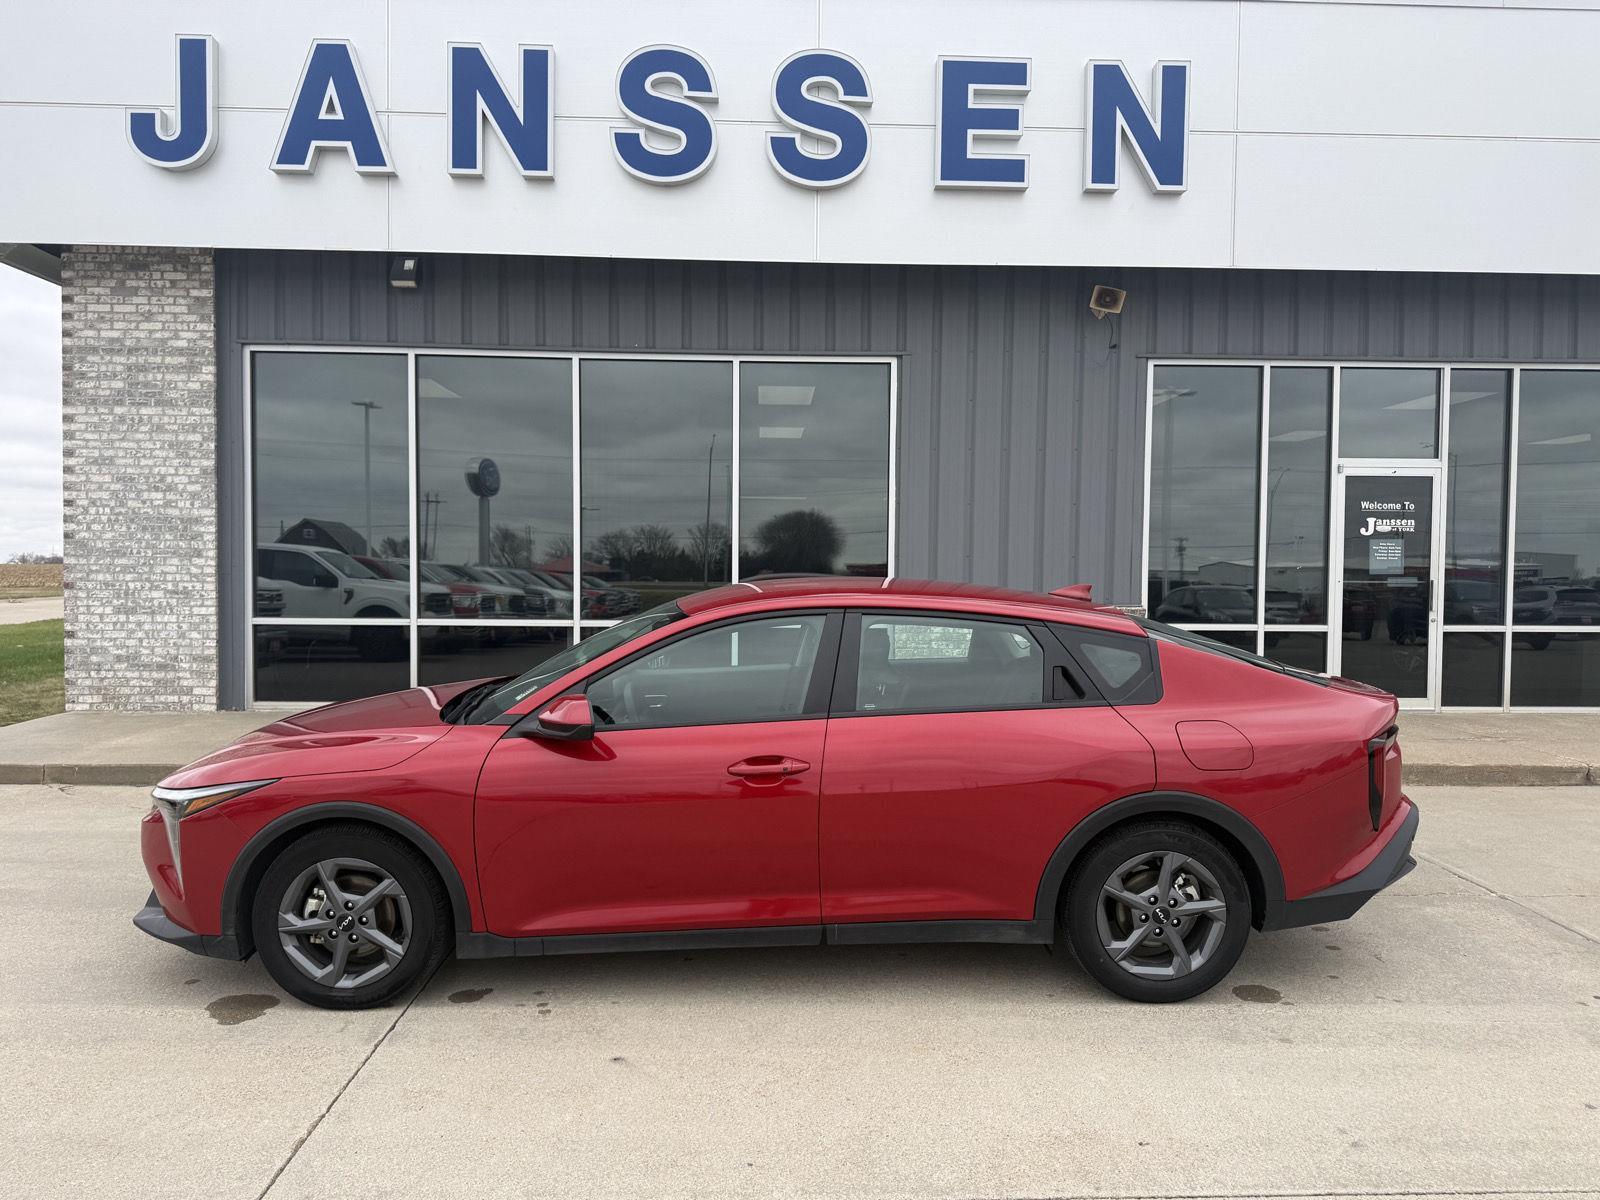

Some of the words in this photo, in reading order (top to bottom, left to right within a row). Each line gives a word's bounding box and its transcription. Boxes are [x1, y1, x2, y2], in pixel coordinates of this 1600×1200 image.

[125, 34, 1192, 195] JANSSEN
[1361, 501, 1401, 510] Welcome
[1404, 501, 1415, 510] To
[1360, 517, 1415, 536] Janssen
